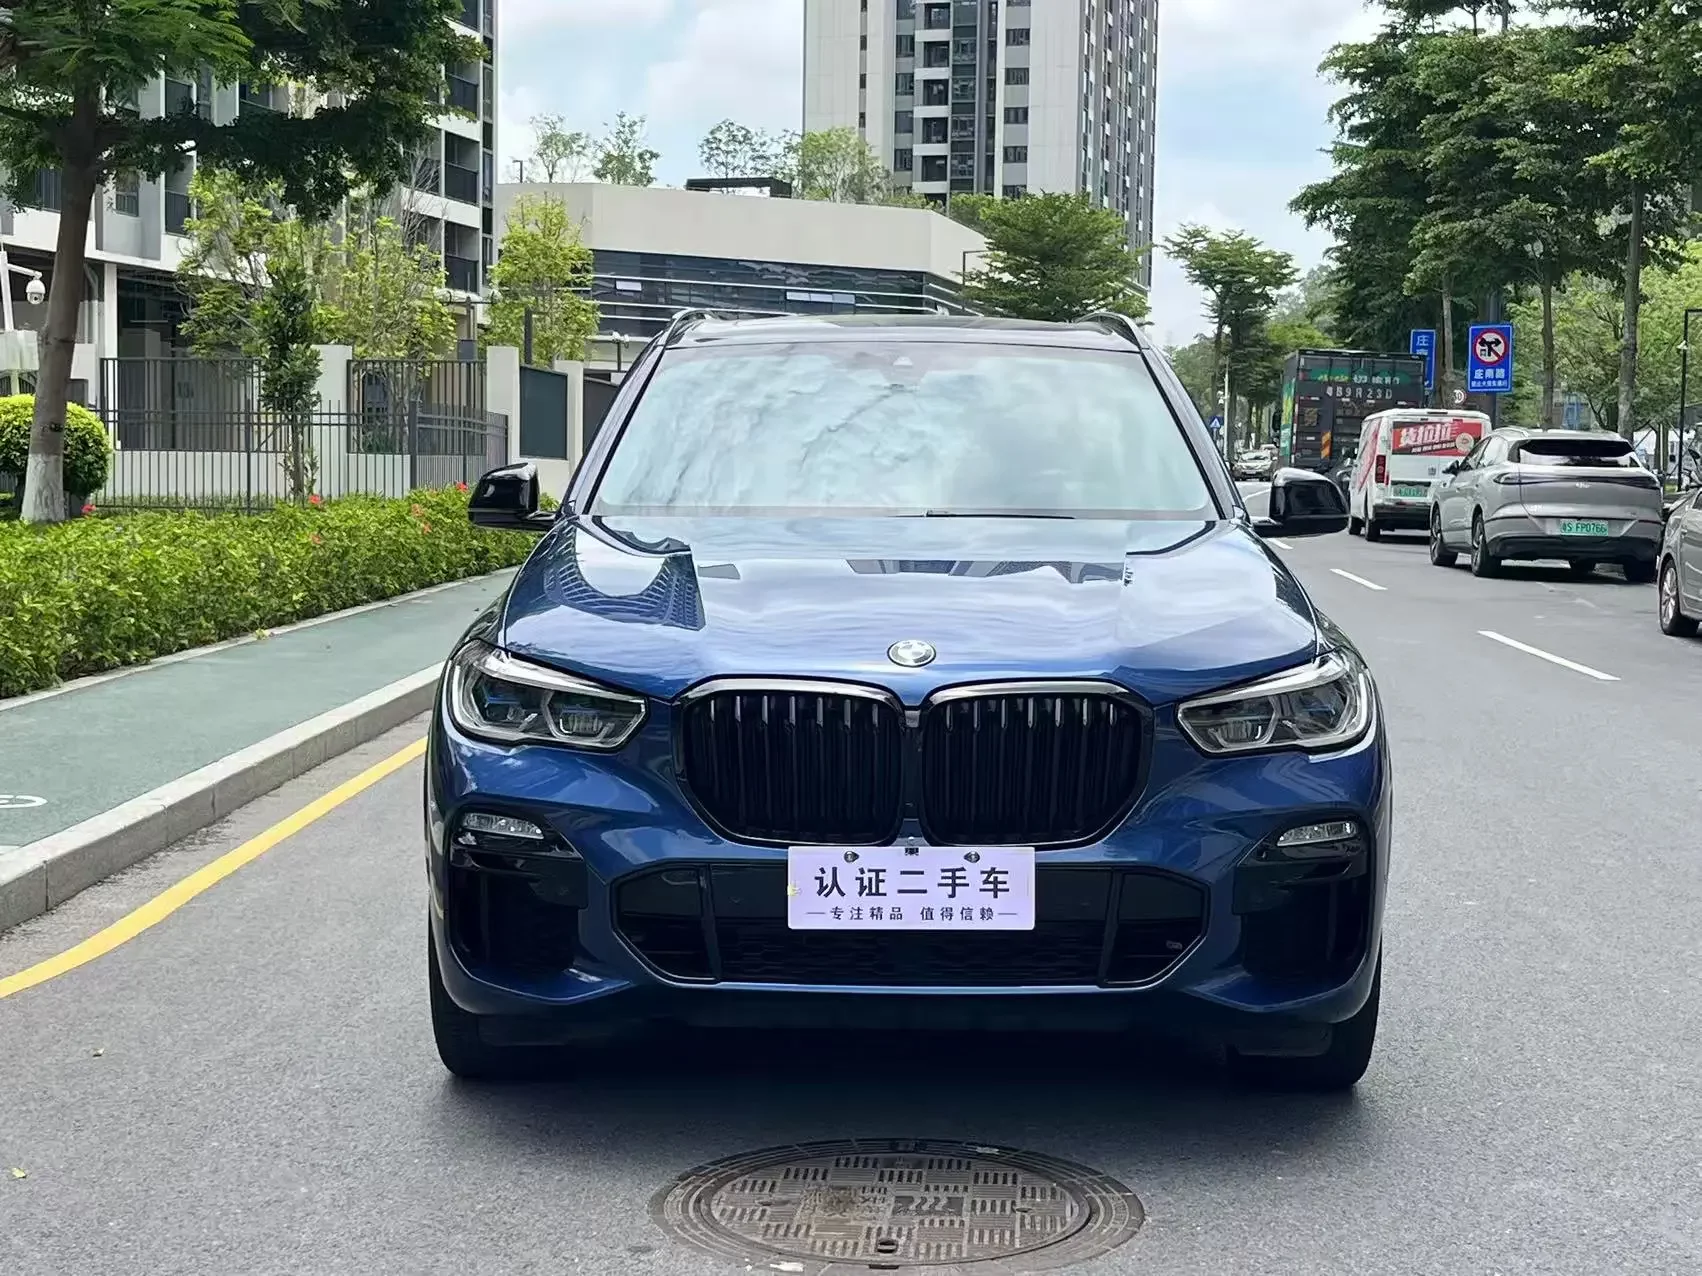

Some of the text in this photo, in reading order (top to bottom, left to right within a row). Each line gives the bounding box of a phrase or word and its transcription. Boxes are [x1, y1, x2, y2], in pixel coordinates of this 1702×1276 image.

[814, 866, 1010, 899] 认证二手车
[830, 906, 994, 921] 专注精品 值得信赖
